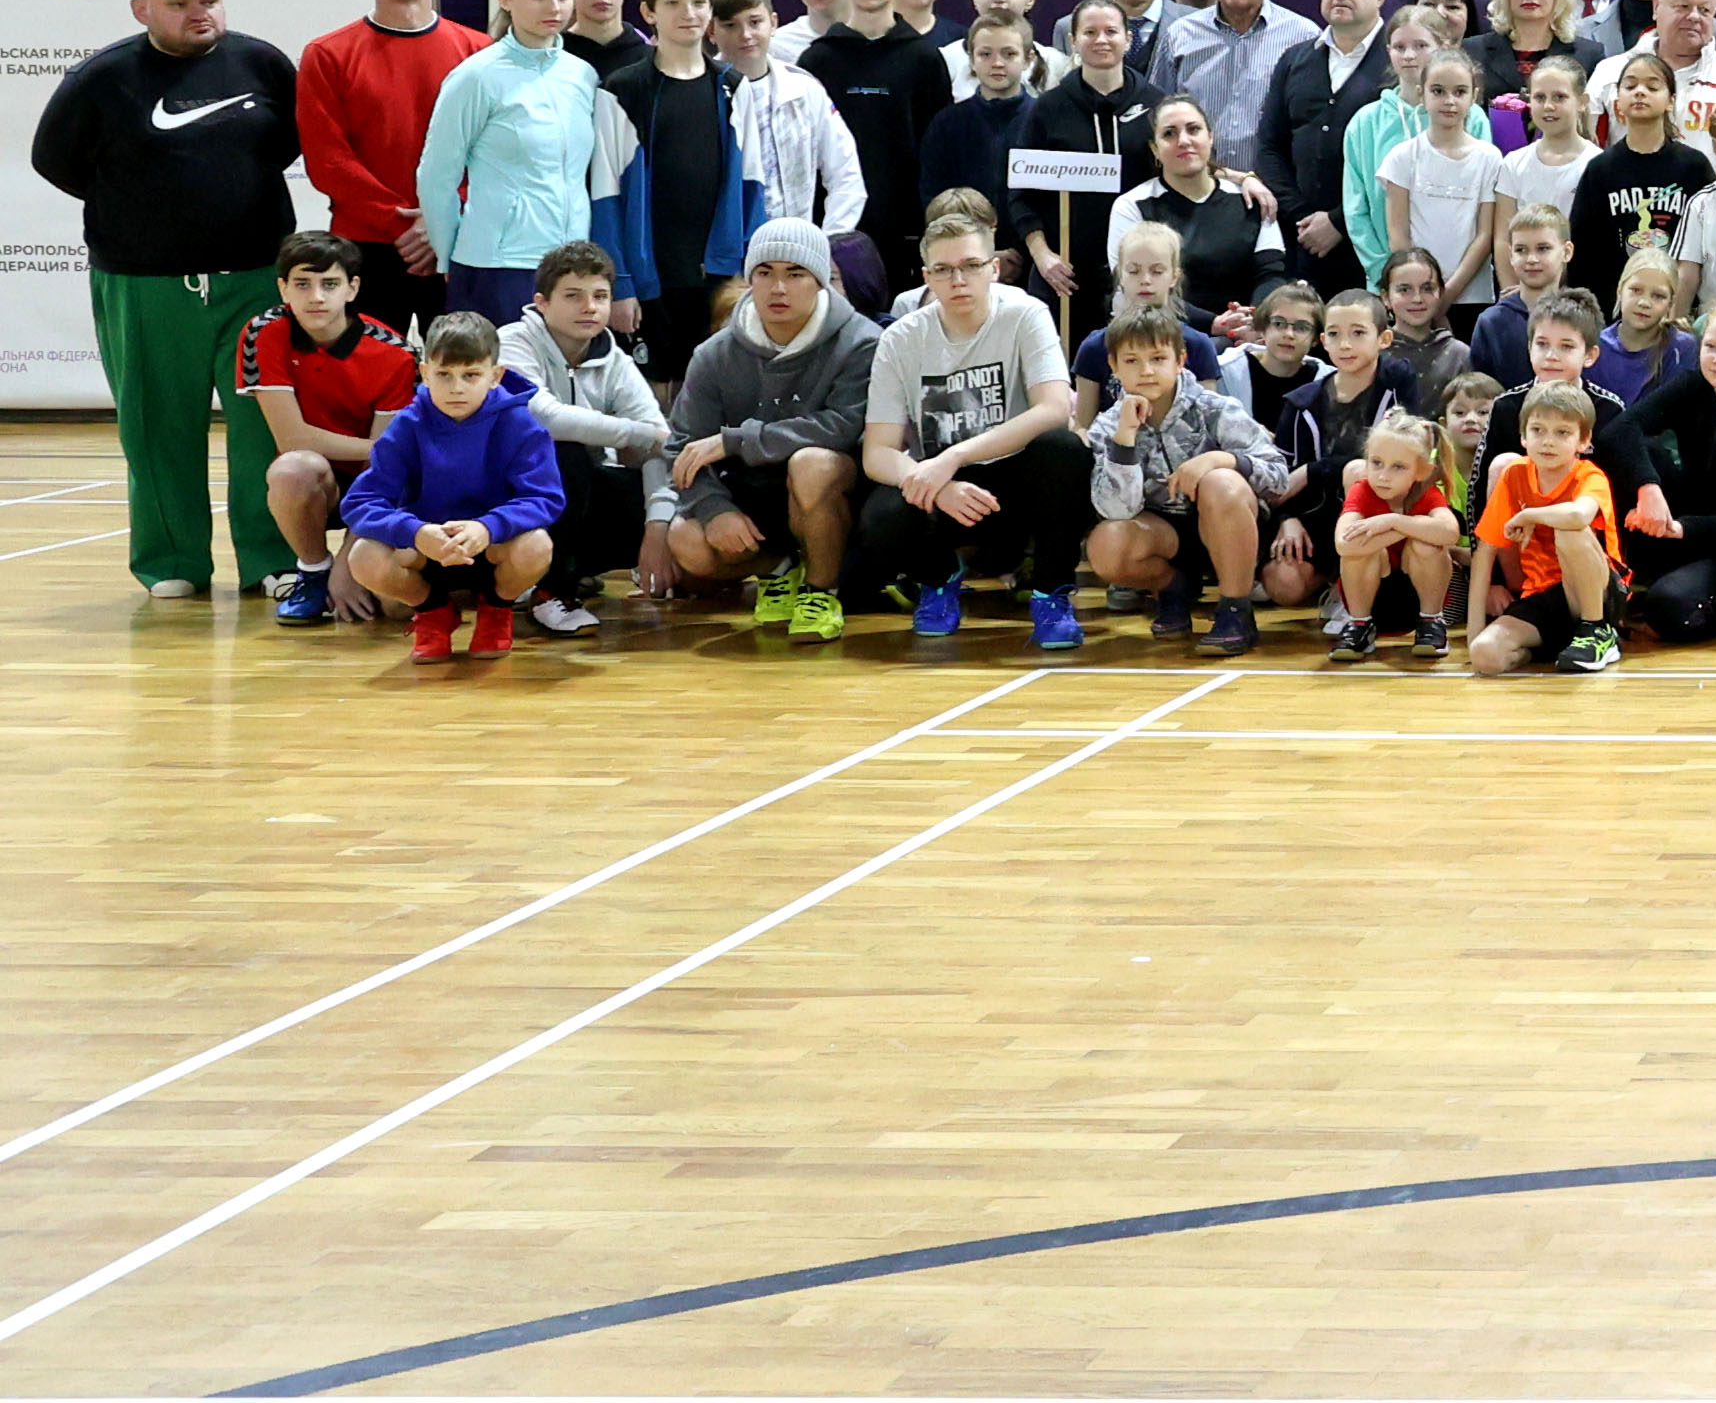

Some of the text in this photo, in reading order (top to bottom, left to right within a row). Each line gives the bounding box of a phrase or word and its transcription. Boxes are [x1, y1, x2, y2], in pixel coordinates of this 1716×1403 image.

[1011, 158, 1119, 180] Ставрополь
[1608, 190, 1643, 216] PAD
[0, 245, 87, 256] ВРОПОЛЬС
[965, 365, 1001, 388] NOT
[981, 385, 1002, 407] BE
[945, 404, 1004, 433] AFRAID
